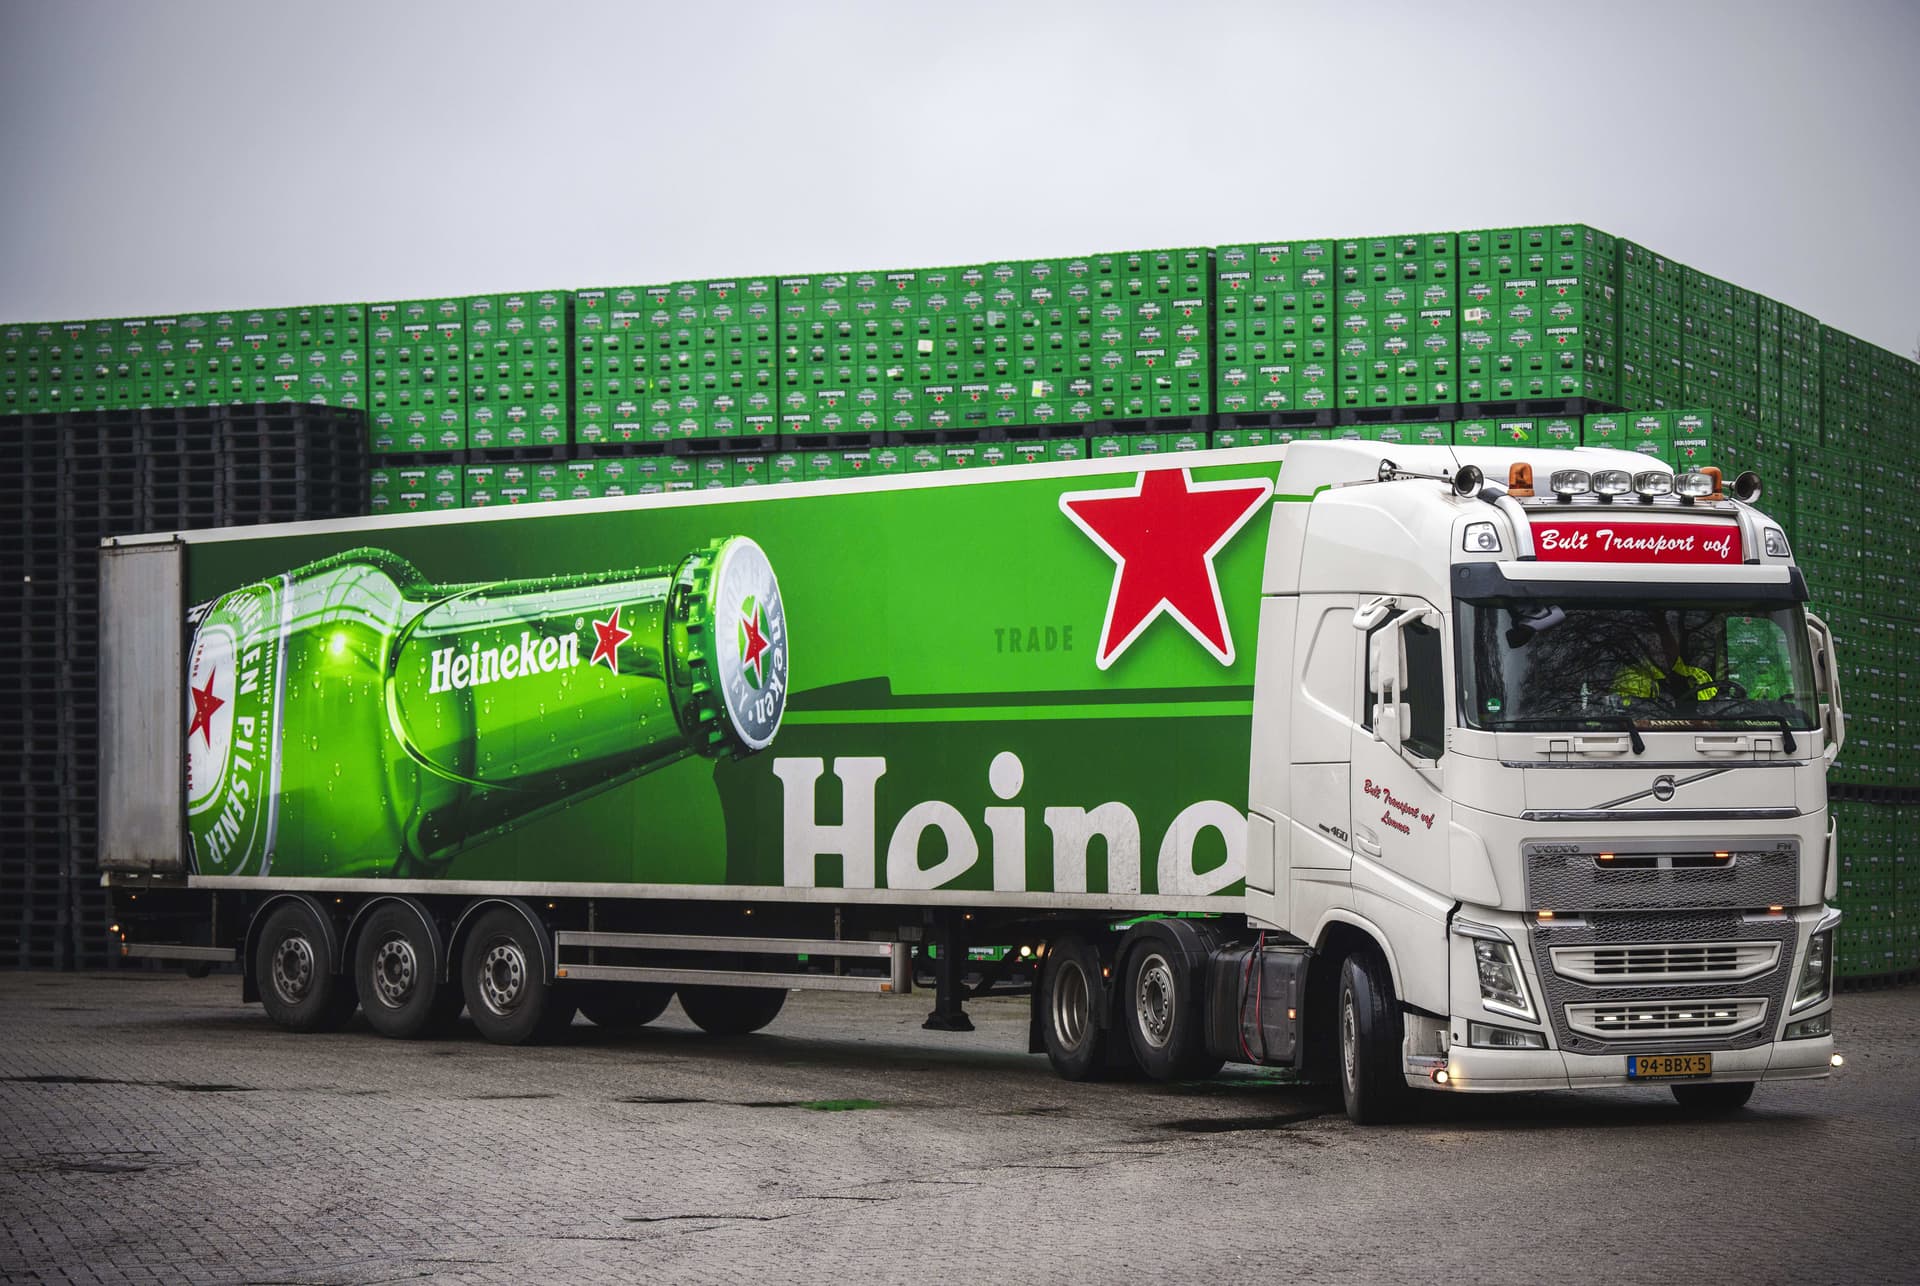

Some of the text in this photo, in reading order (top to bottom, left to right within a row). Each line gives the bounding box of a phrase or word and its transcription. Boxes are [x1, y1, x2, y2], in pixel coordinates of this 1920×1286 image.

[1540, 529, 1731, 559] Bult Transport vof
[994, 624, 1072, 654] TRADE
[429, 632, 580, 694] Heineken
[259, 710, 270, 762] RECEPT
[204, 717, 255, 864] PILSENER
[1383, 788, 1419, 819] Transport
[773, 751, 1249, 896] Heine
[1331, 826, 1348, 841] 460
[1532, 844, 1580, 853] VOLVO
[1641, 1058, 1706, 1073] 94-BBX-5
